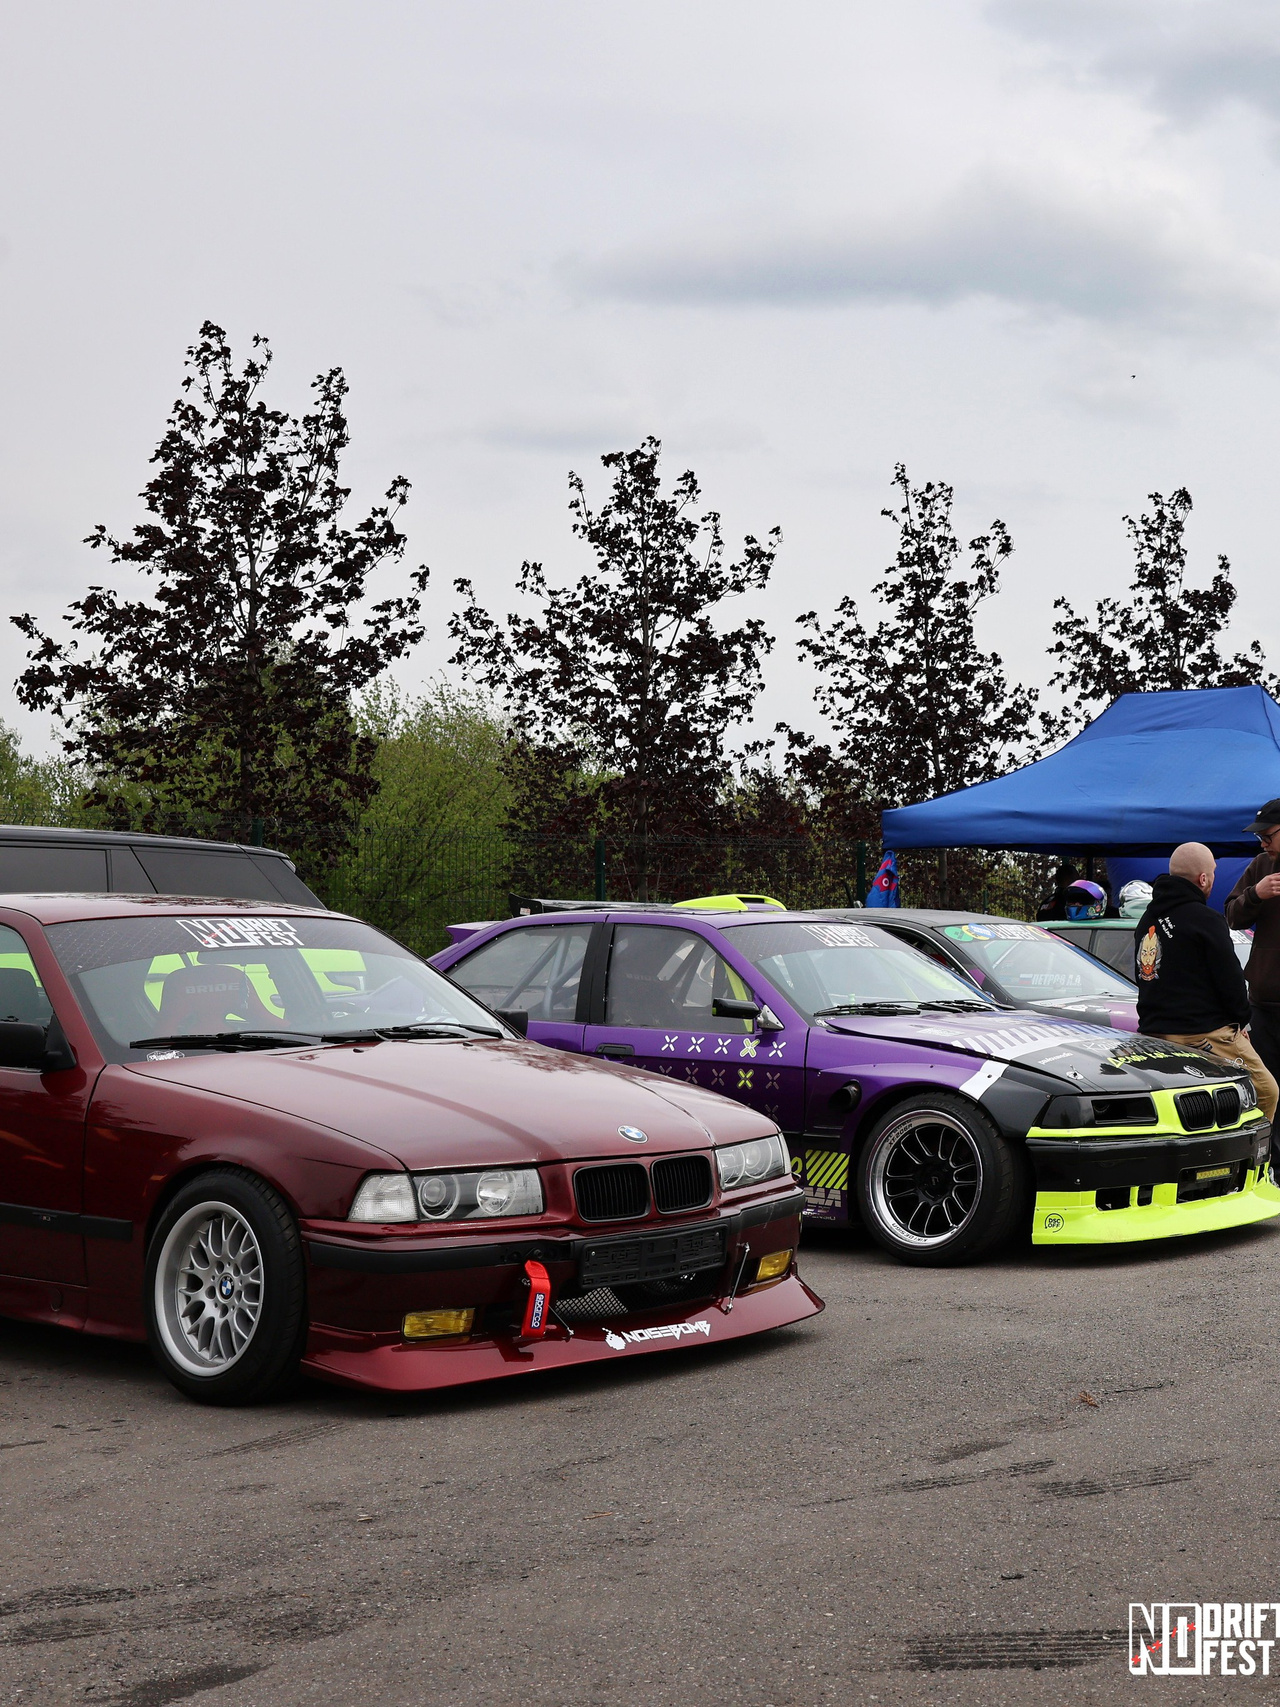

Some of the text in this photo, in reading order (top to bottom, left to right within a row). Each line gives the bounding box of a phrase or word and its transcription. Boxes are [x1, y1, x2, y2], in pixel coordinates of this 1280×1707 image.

[229, 918, 297, 932] DRIFT
[245, 931, 304, 946] FEST
[186, 982, 240, 994] BRIDE
[532, 1294, 545, 1328] sparco
[621, 1320, 711, 1343] NOISEBOMB
